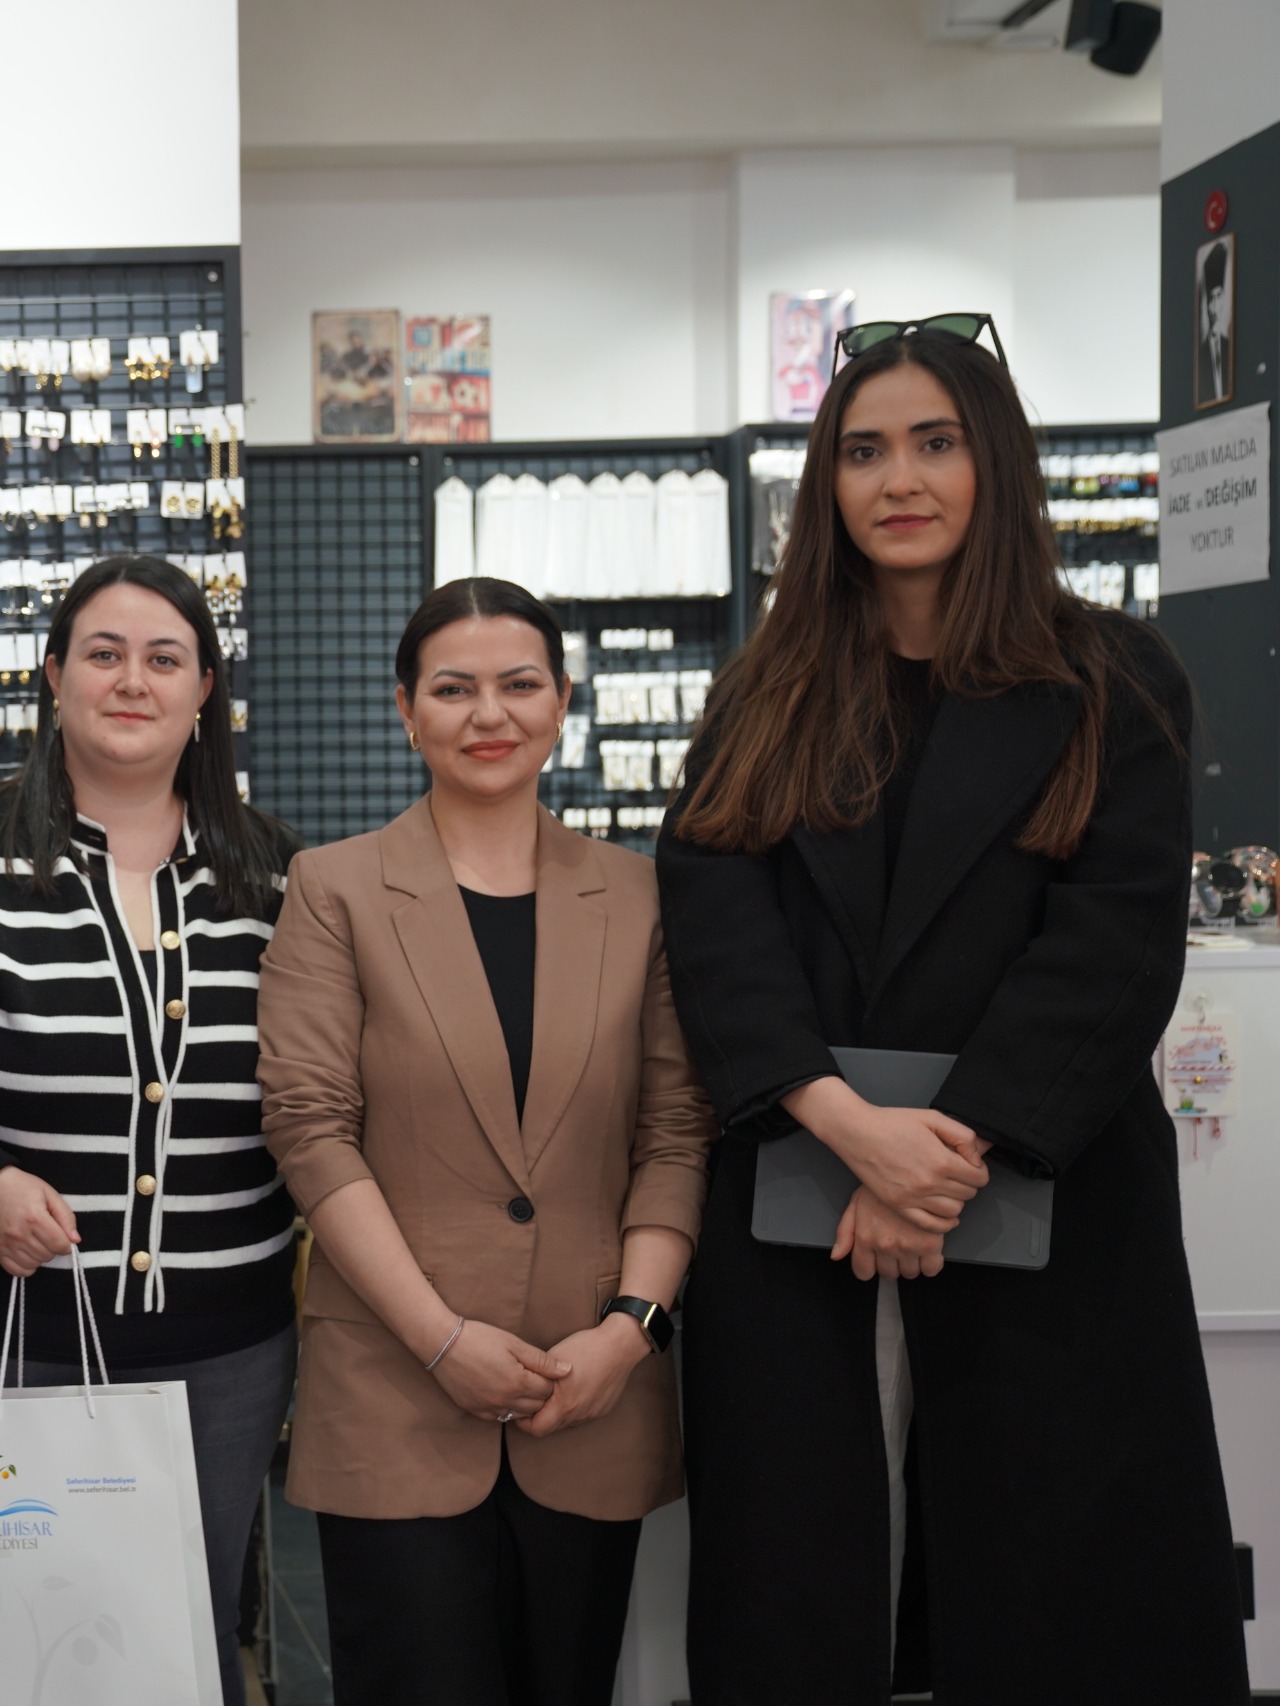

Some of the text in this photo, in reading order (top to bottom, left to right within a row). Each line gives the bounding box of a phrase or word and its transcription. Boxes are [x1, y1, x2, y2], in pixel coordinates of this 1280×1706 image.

[1170, 437, 1257, 478] SATILAN MALDA
[1206, 476, 1257, 507] DEĞİŞİM
[1190, 526, 1234, 552] YOKTUR
